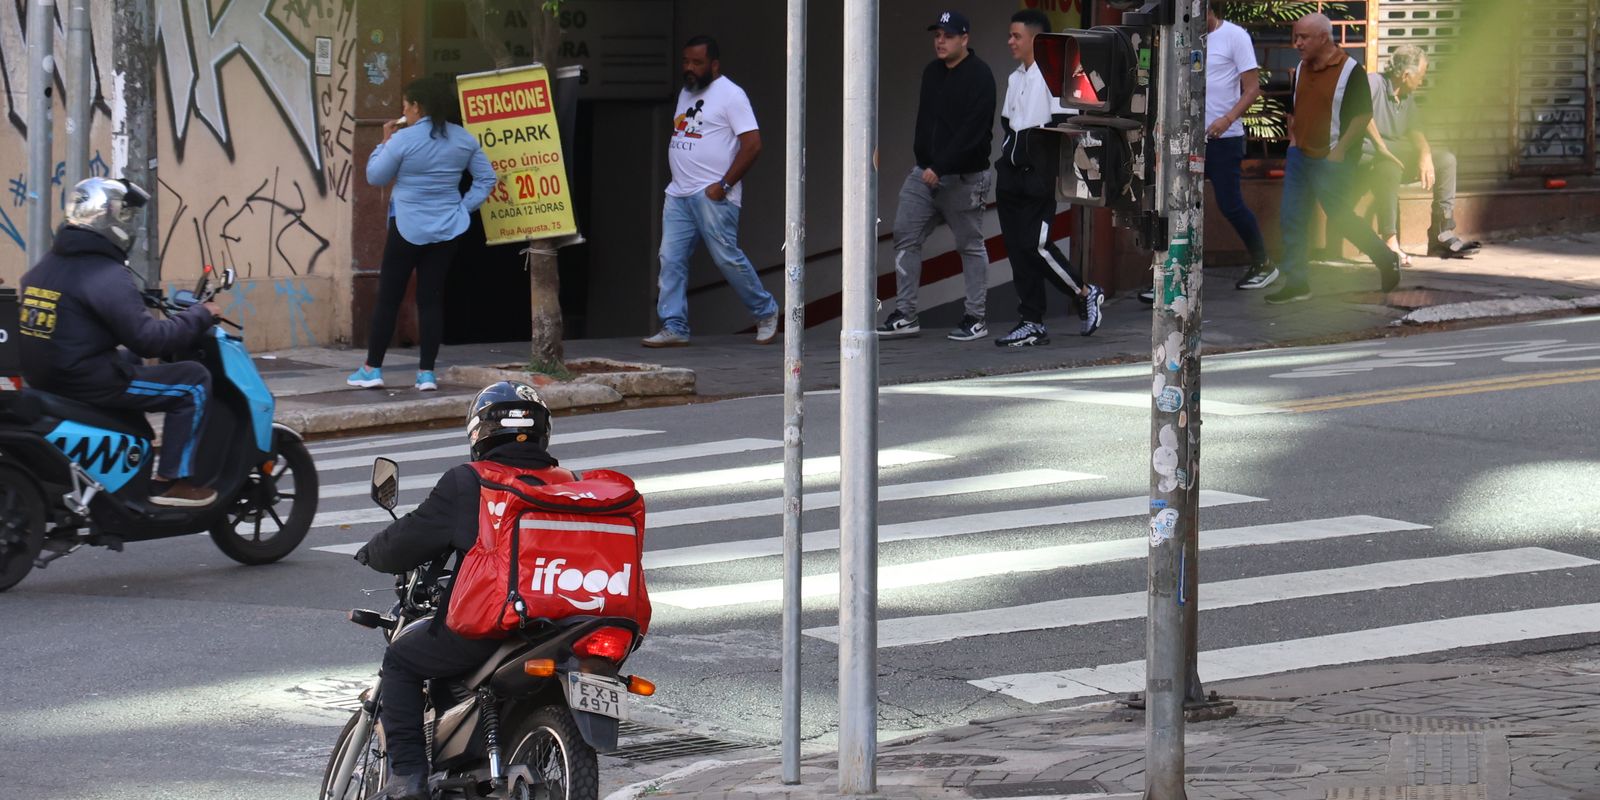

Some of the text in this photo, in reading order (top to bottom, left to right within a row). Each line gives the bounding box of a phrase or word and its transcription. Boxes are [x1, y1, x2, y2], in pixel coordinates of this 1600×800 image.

[467, 86, 546, 117] ESTACIONE
[490, 151, 560, 173] eço único
[490, 201, 565, 220] A CADA 12 HORAS
[499, 227, 515, 236] Rua
[551, 221, 562, 230] 75
[531, 557, 632, 597] ifood
[580, 683, 619, 703] EXB
[580, 696, 619, 716] 4971
